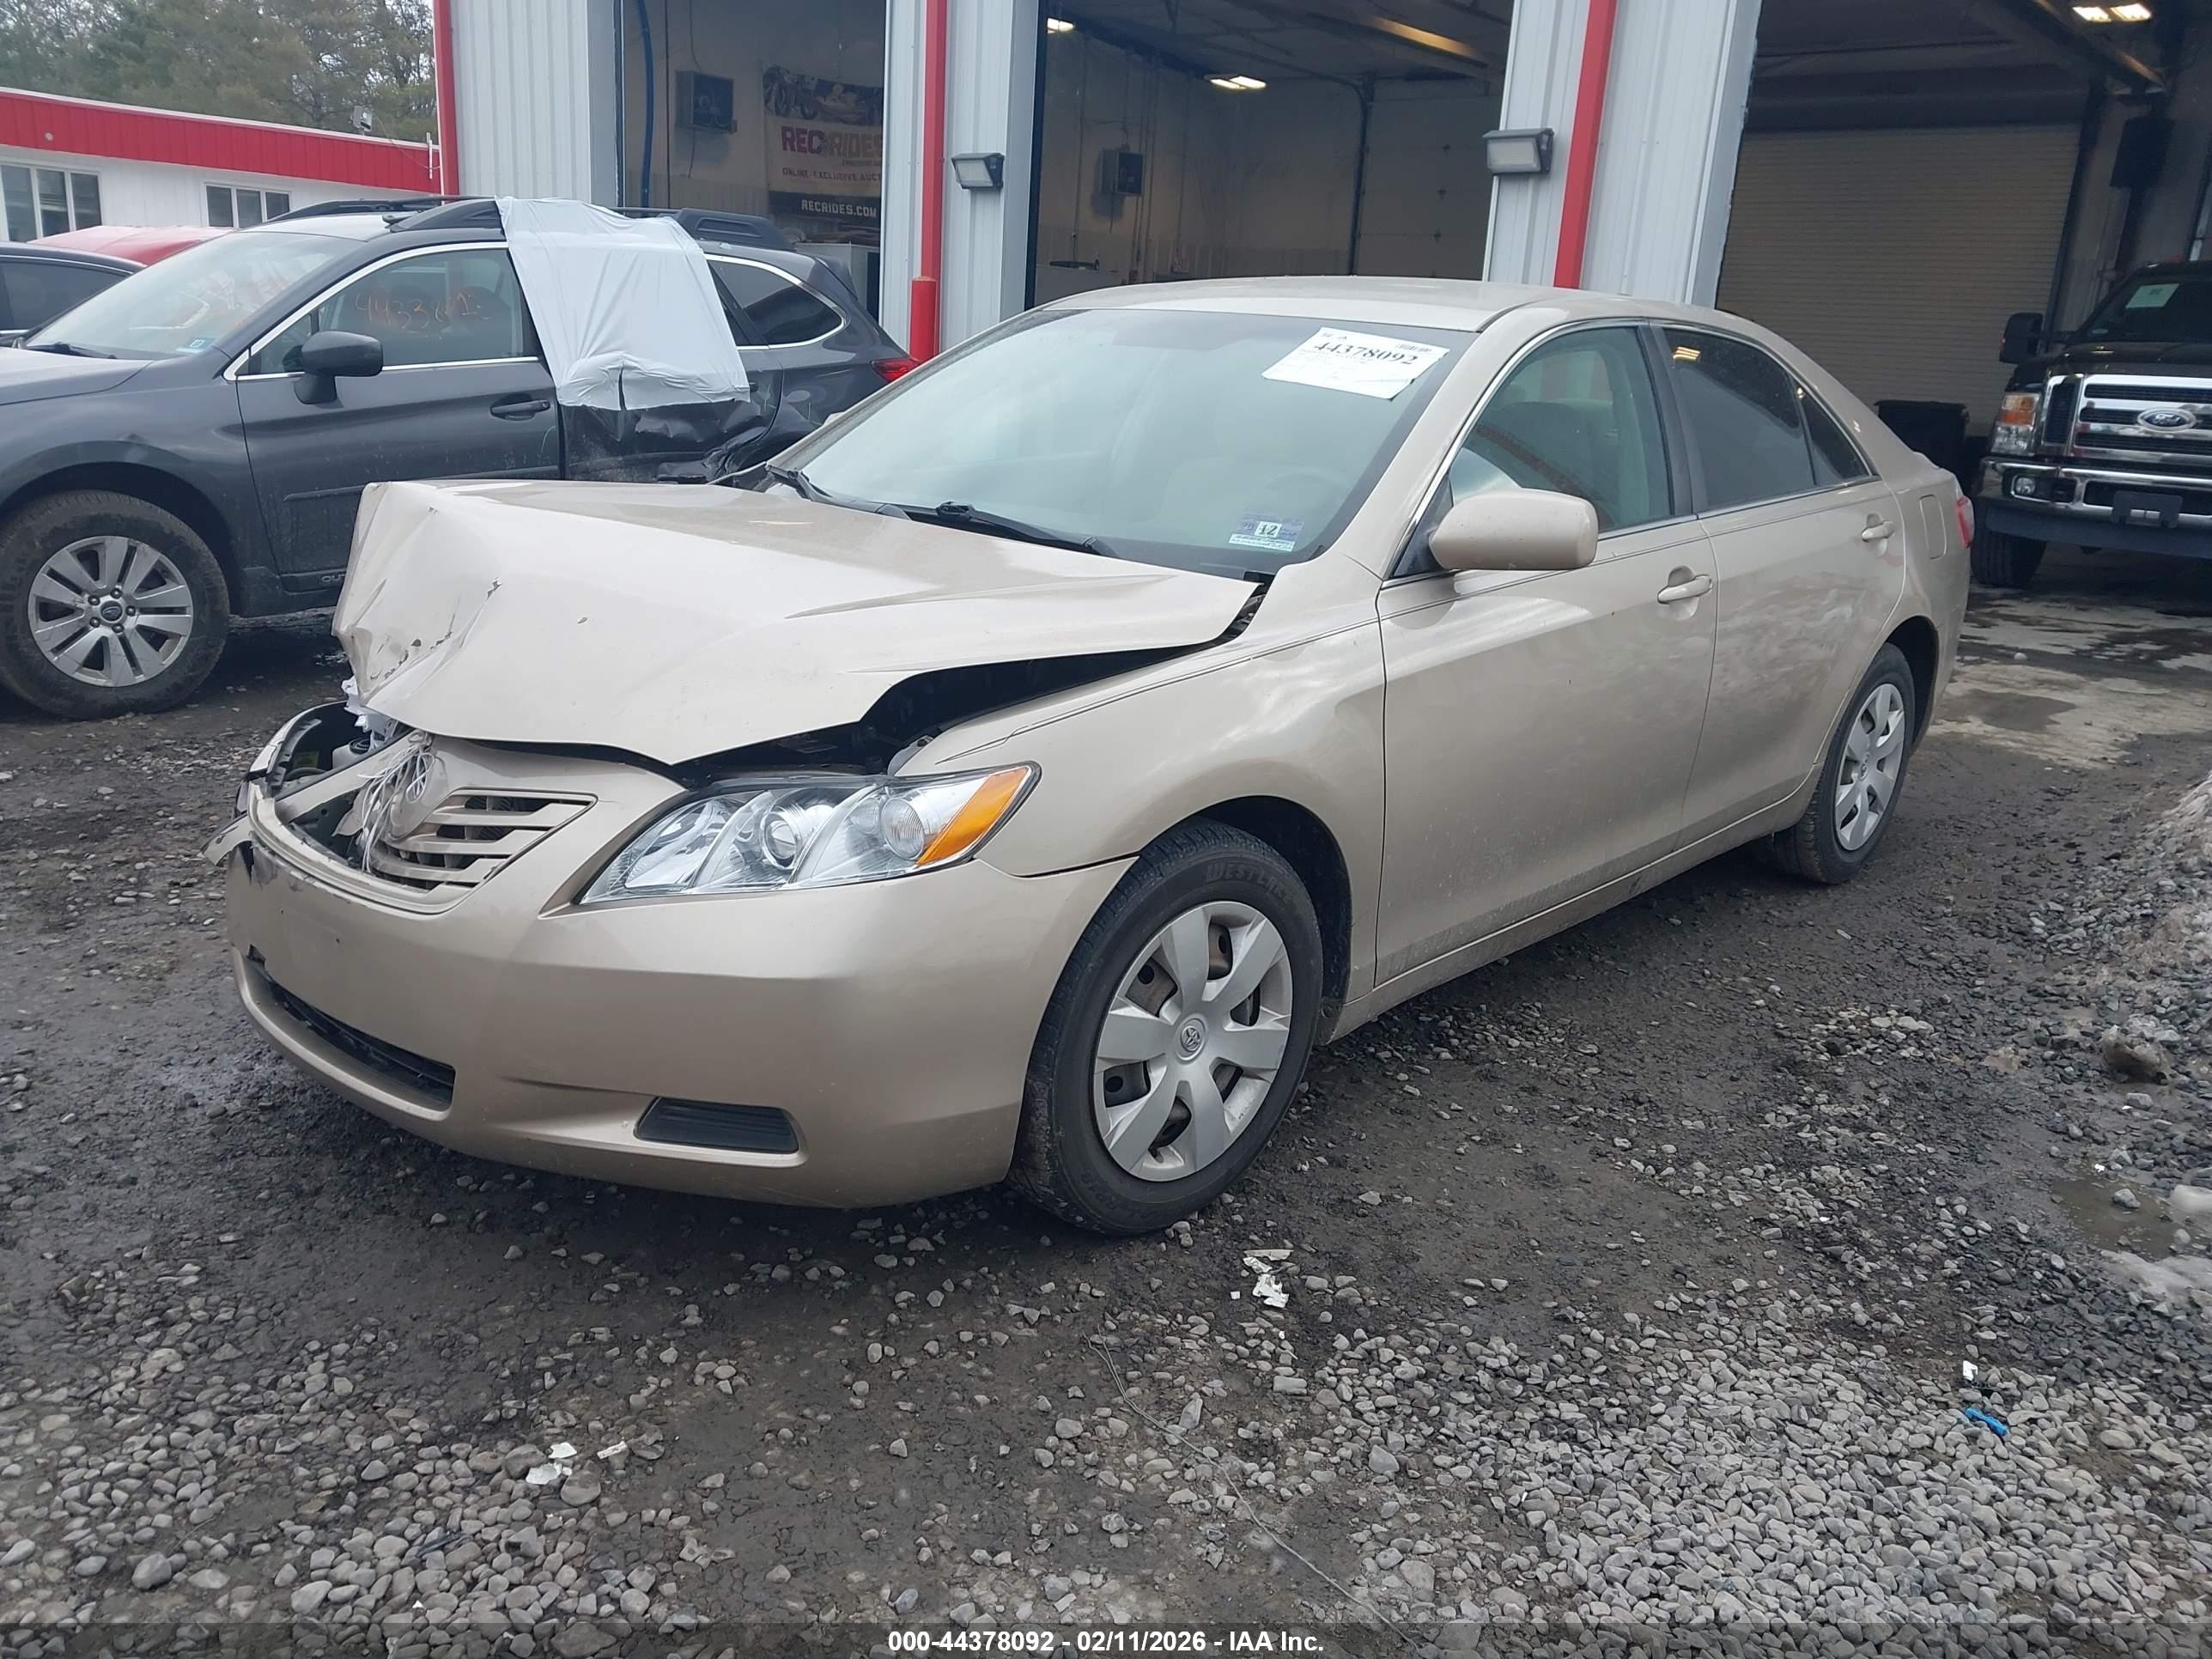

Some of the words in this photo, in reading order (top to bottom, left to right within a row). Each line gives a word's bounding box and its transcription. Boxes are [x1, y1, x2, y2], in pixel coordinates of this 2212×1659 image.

[801, 199, 877, 217] RECRIDES.COM
[1311, 342, 1419, 365] 44378092
[1259, 523, 1279, 536] 12
